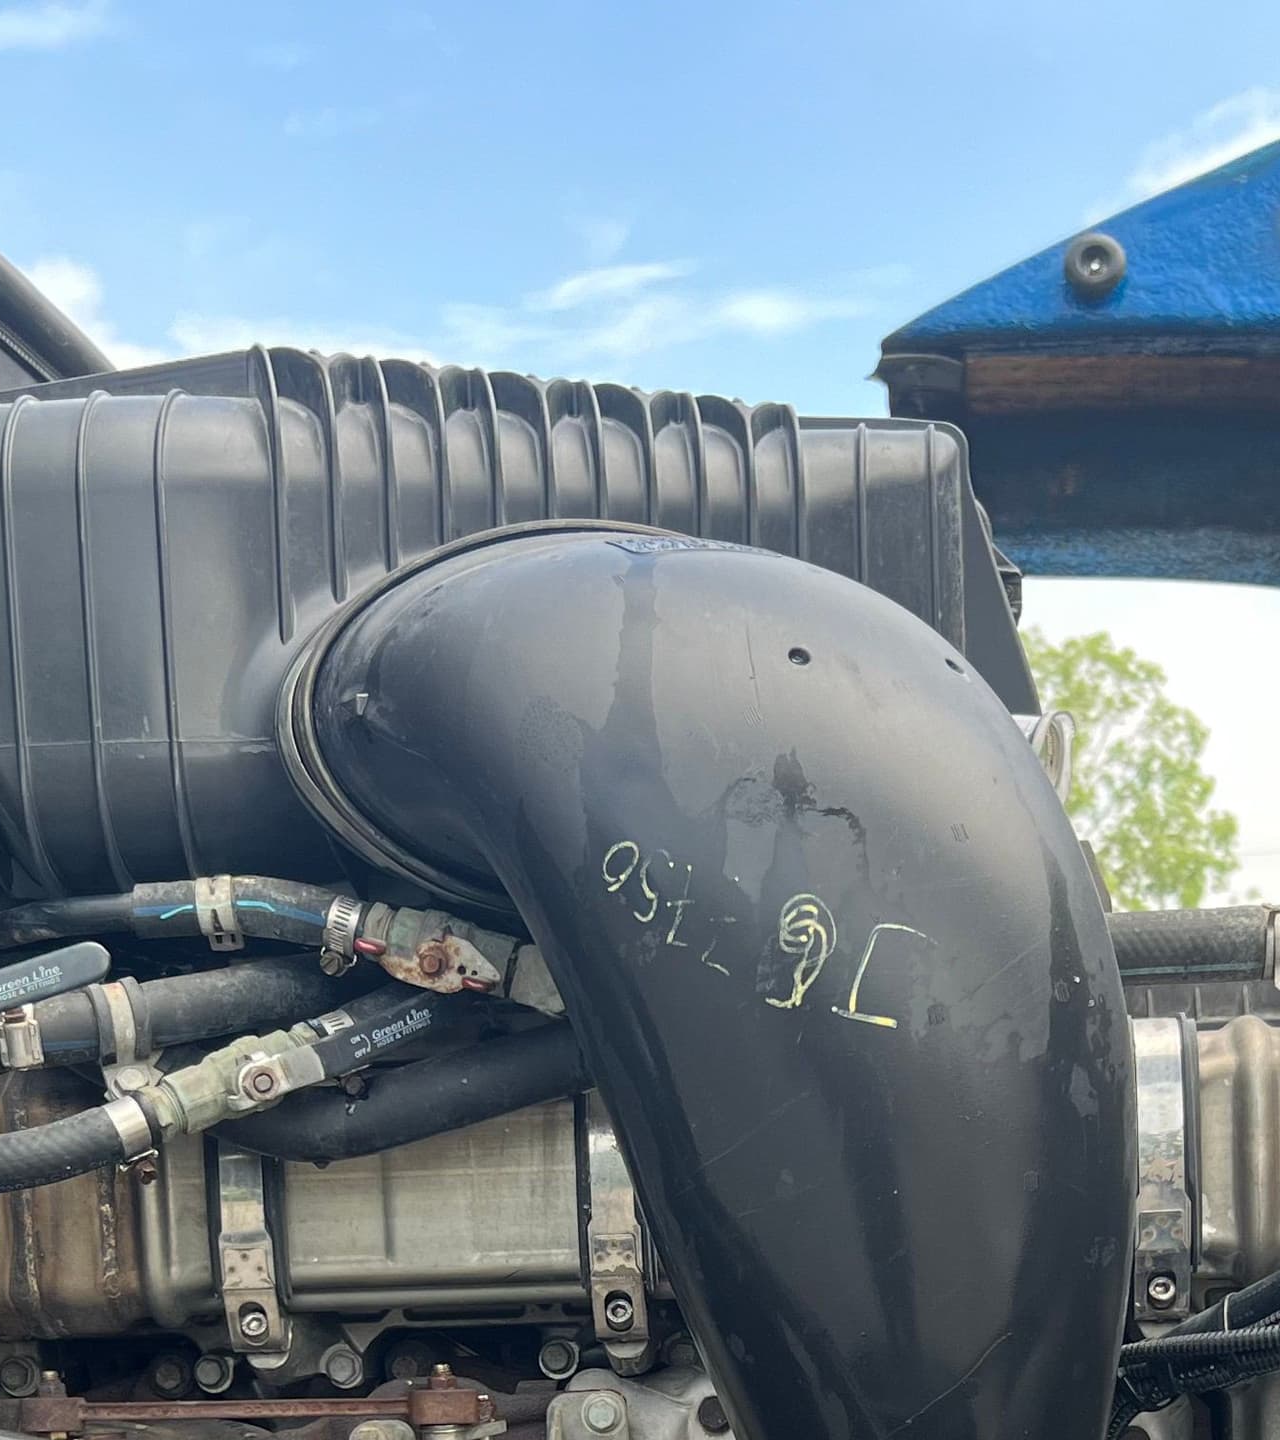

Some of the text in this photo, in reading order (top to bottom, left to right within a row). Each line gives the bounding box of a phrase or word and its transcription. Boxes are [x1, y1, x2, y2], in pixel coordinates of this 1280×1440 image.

[32, 965, 60, 981] Line
[372, 1008, 430, 1040] Green Line
